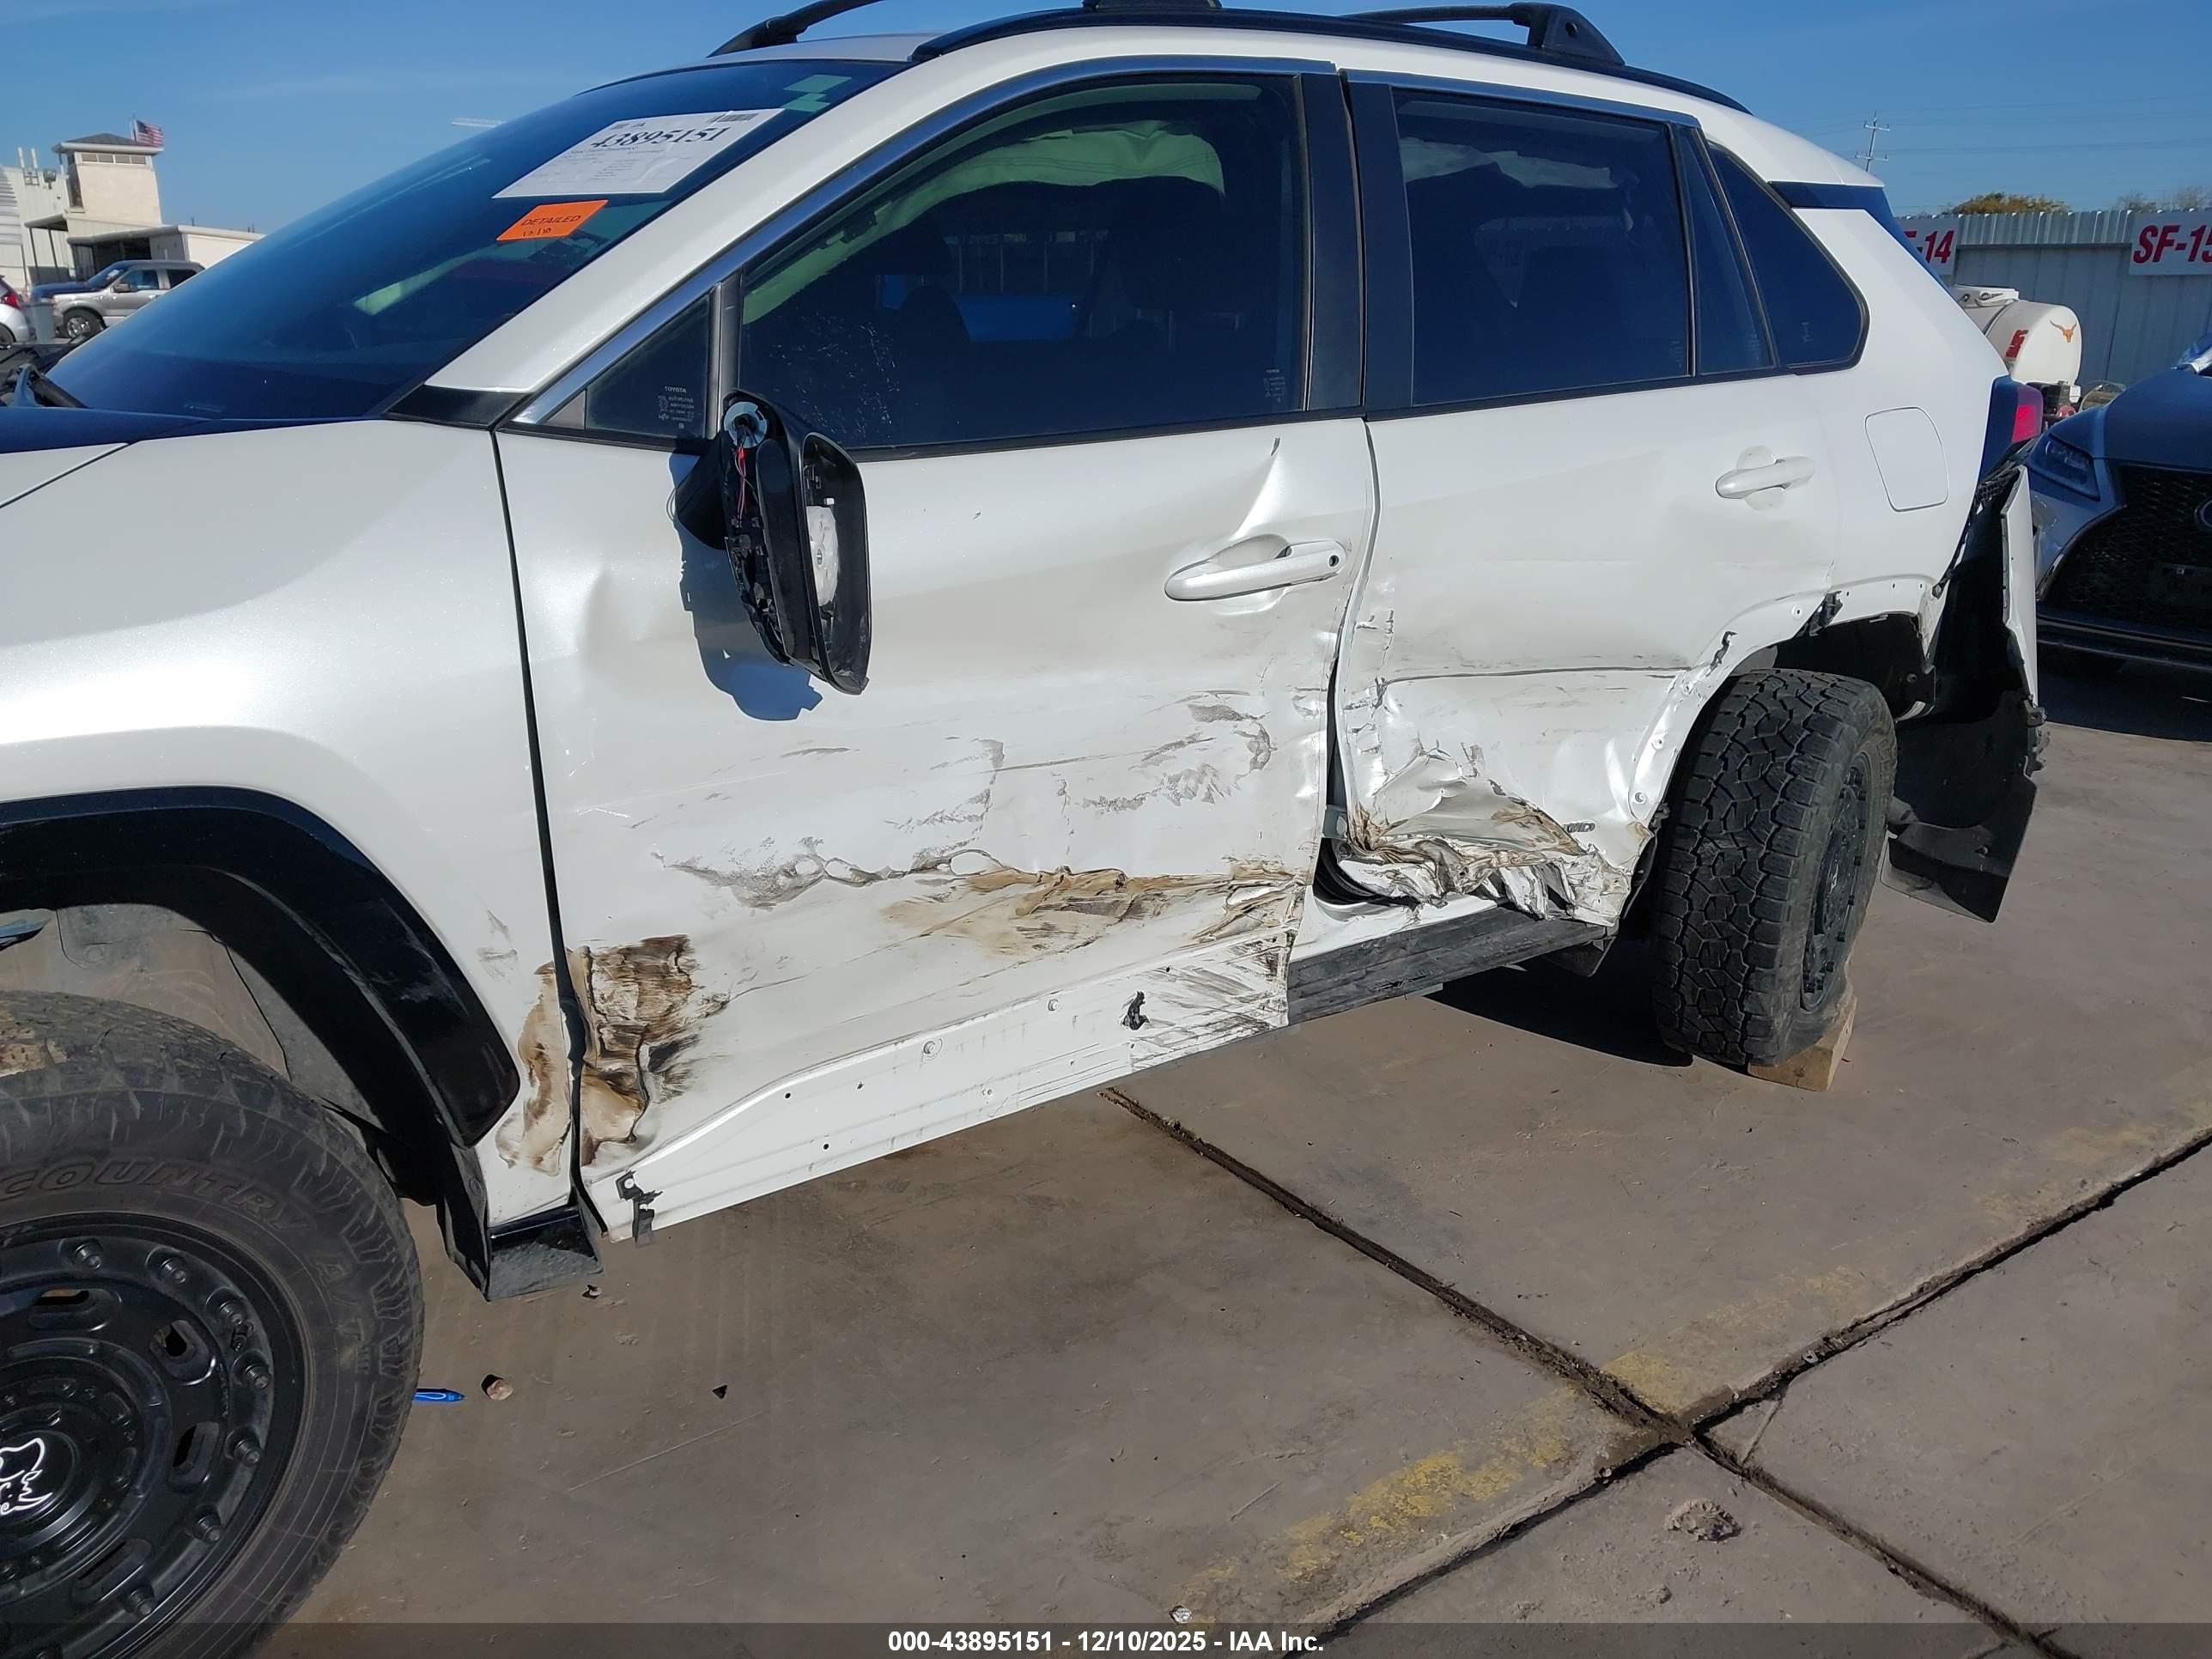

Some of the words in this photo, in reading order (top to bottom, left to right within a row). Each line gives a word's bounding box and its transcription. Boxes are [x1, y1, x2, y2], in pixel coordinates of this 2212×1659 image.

[591, 127, 732, 148] 43895151
[520, 215, 582, 226] DETAILED
[0, 1159, 318, 1231] COUNTRY
